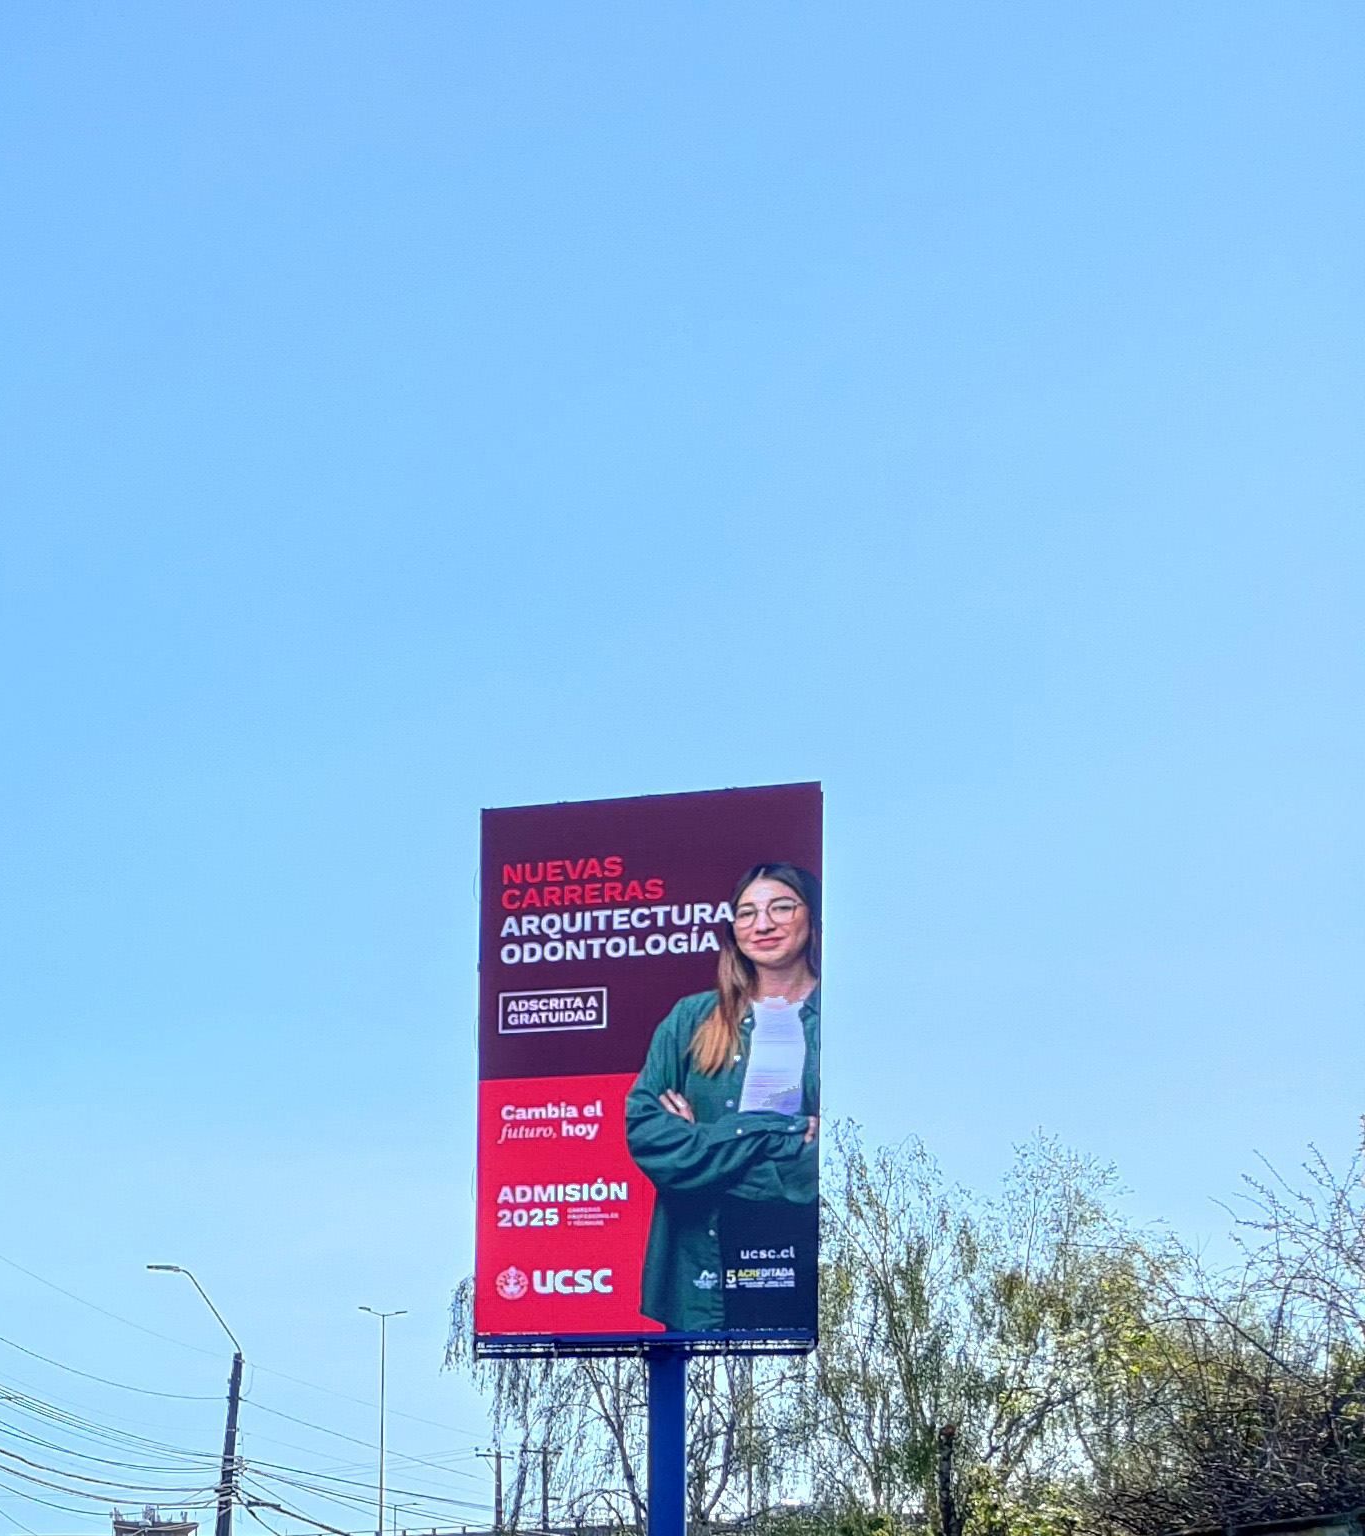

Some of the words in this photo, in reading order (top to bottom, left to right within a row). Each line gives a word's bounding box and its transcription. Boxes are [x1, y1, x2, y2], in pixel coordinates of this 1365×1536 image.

[502, 856, 624, 886] NUEVAS
[501, 878, 665, 910] CARRERAS
[500, 902, 736, 938] ARQUITECTURA
[500, 926, 720, 965] ODONTOLOGÍA
[507, 996, 585, 1013] ADSCRITA
[587, 996, 598, 1009] A
[507, 1009, 597, 1026] GRATUIDAD
[500, 1102, 578, 1121] Cambia
[583, 1100, 604, 1118] el
[496, 1124, 558, 1145] futuro,
[561, 1120, 600, 1140] hoy
[497, 1178, 628, 1204] ADMISIÓN
[497, 1208, 559, 1227] 2025
[740, 1245, 795, 1260] ucsc.cl
[533, 1269, 613, 1294] UCSC
[726, 1269, 737, 1284] 5
[737, 1267, 795, 1278] ACREDITADA
